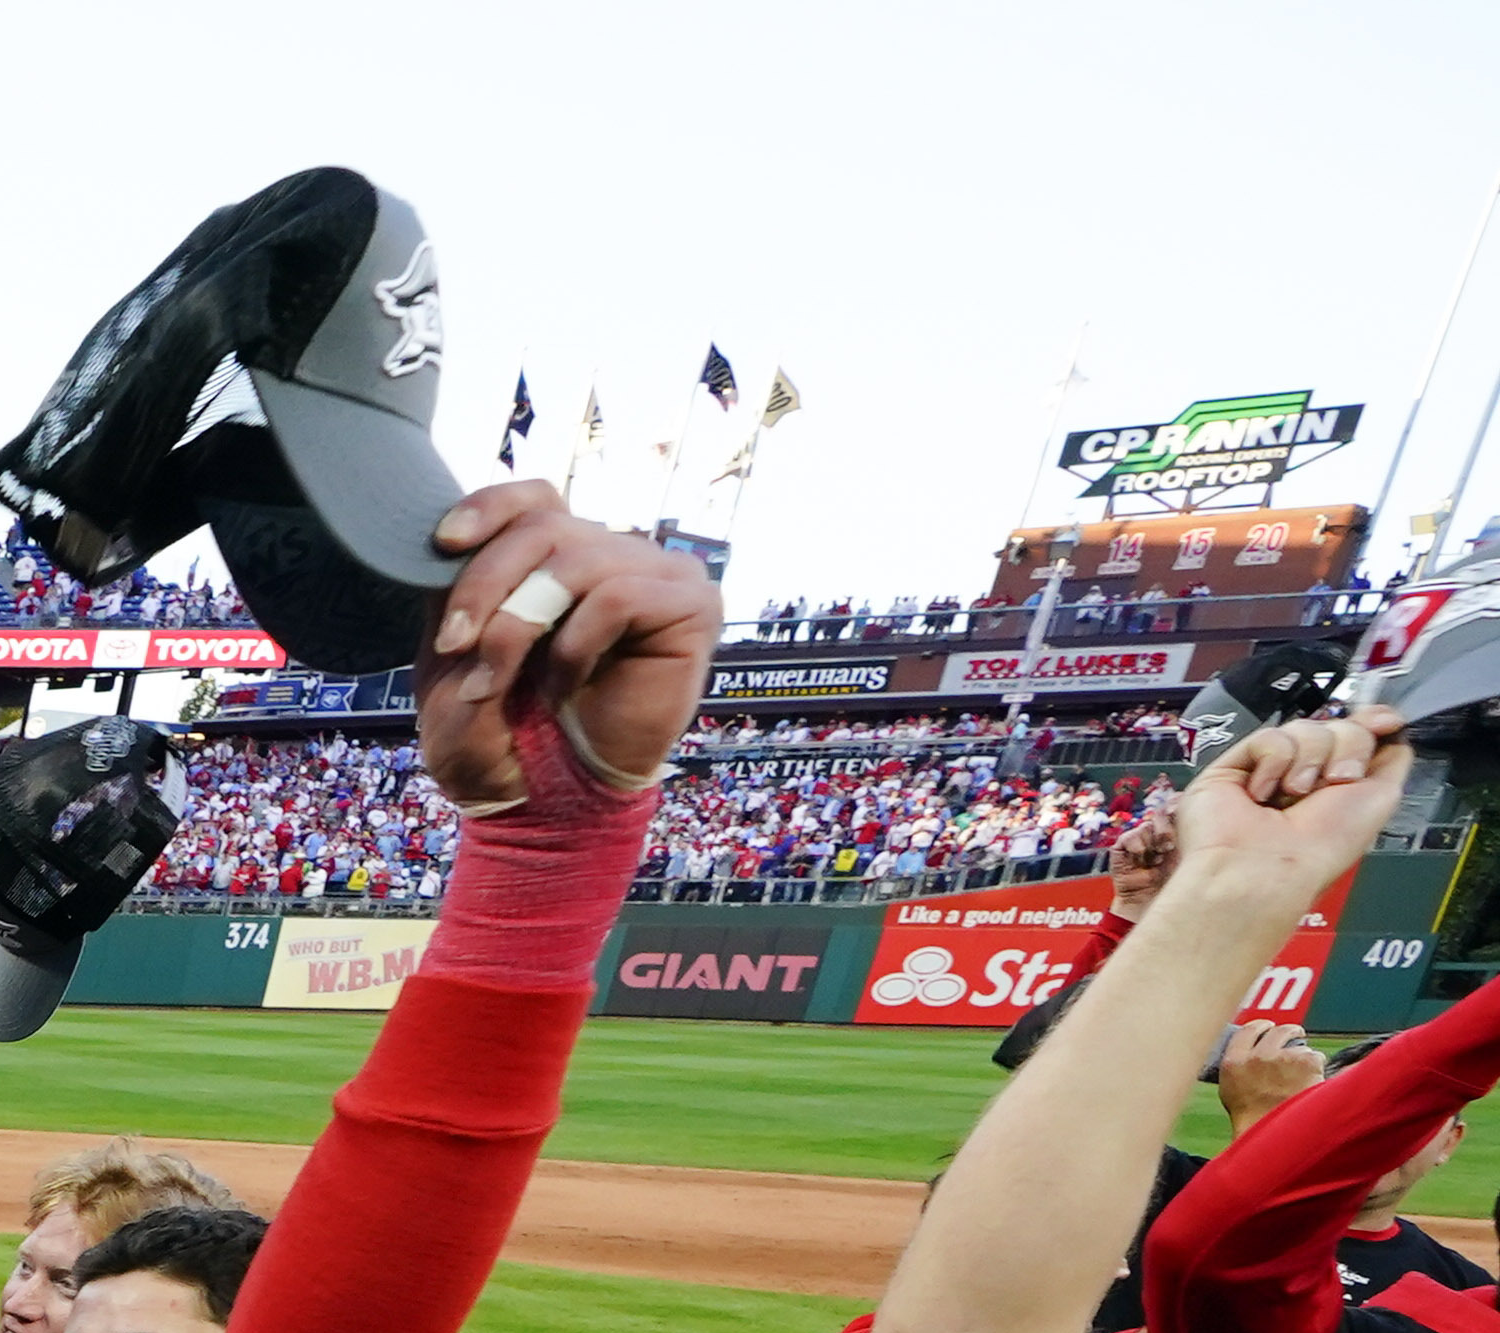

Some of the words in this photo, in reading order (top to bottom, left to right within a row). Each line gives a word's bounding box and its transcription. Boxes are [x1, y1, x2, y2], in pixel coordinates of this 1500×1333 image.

[1111, 461, 1274, 494] ROOFTOP
[1112, 535, 1142, 562] 14
[1182, 530, 1214, 558] 15
[1248, 524, 1286, 552] 20
[155, 636, 279, 662] TOYOTA
[1055, 651, 1167, 672] LUKE'S
[898, 905, 942, 926] Like
[945, 911, 961, 927] a
[965, 905, 1015, 930] good
[224, 922, 269, 949] 374
[287, 939, 325, 957] WHO
[329, 938, 363, 953] BUT
[1362, 938, 1424, 970] 409
[618, 951, 819, 993] GIANT
